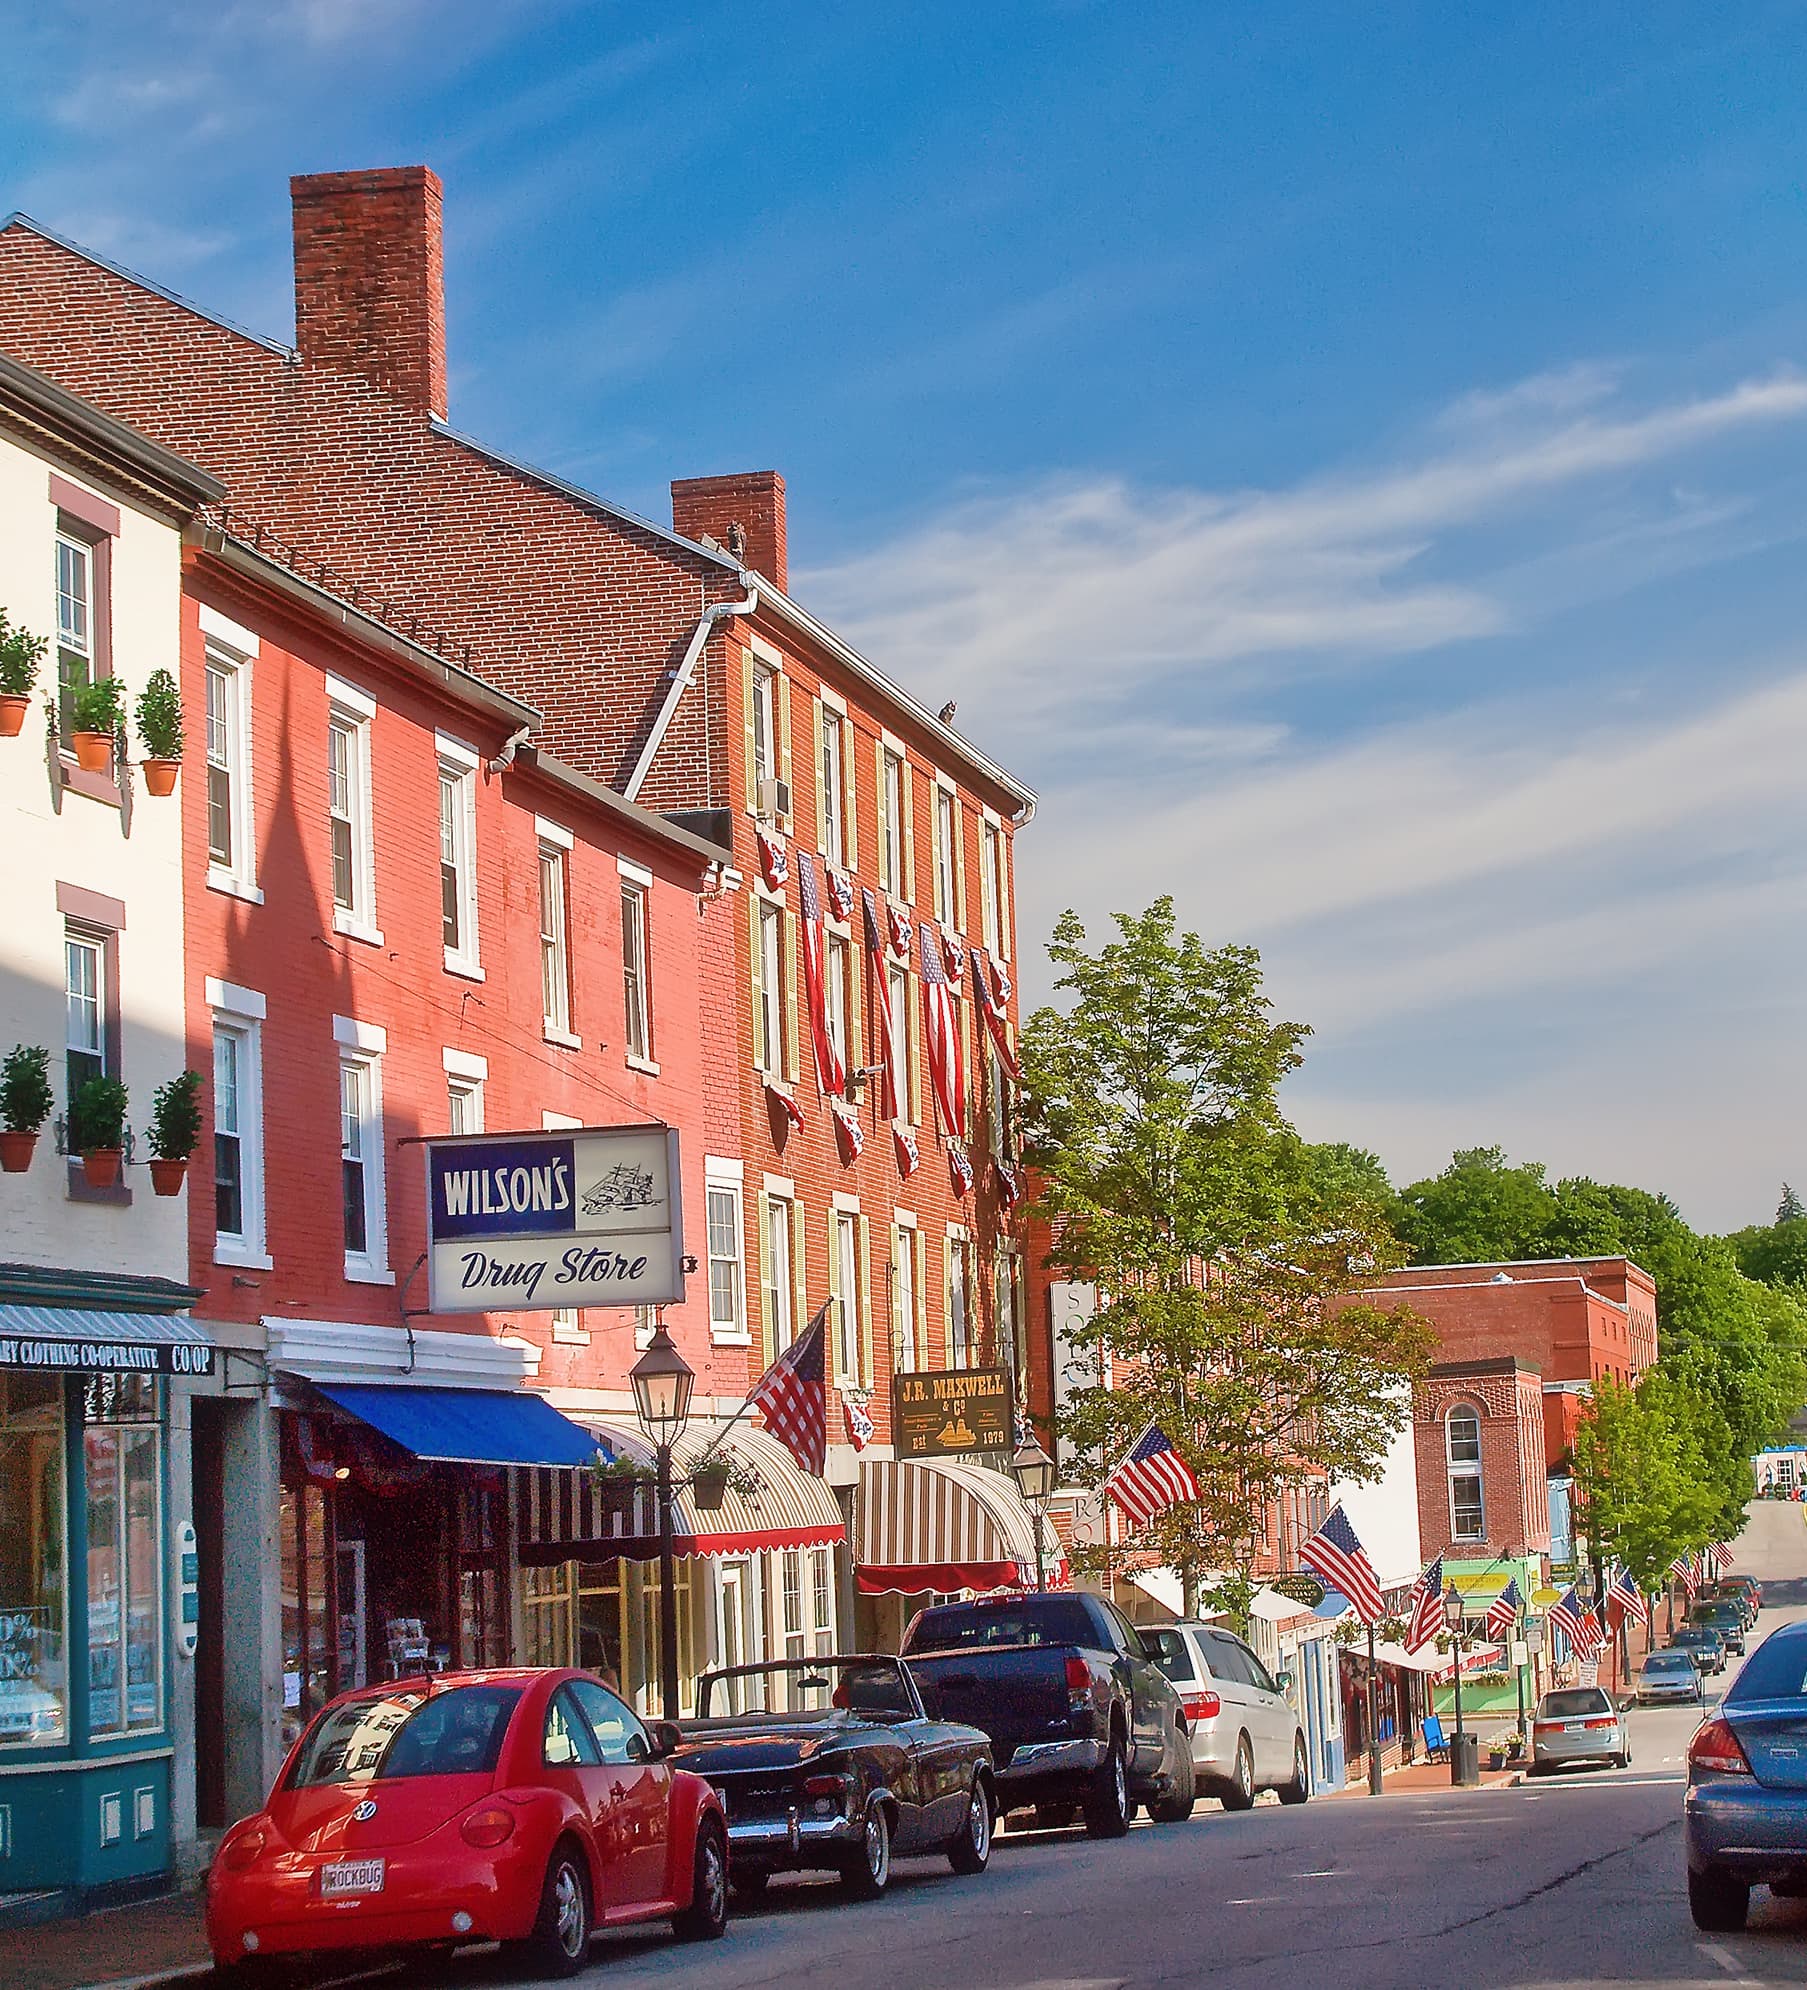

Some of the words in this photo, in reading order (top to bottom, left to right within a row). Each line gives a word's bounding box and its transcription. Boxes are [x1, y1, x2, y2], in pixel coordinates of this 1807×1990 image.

[444, 1156, 568, 1216] WILSON'S
[461, 1251, 547, 1300] Drug
[554, 1247, 647, 1284] Store
[20, 1341, 79, 1366] CLOTHING
[902, 1381, 929, 1402] J.R.
[933, 1375, 1004, 1400] MAXWELL
[983, 1430, 1004, 1445] 1979
[327, 1866, 382, 1889] ROCKBUG
